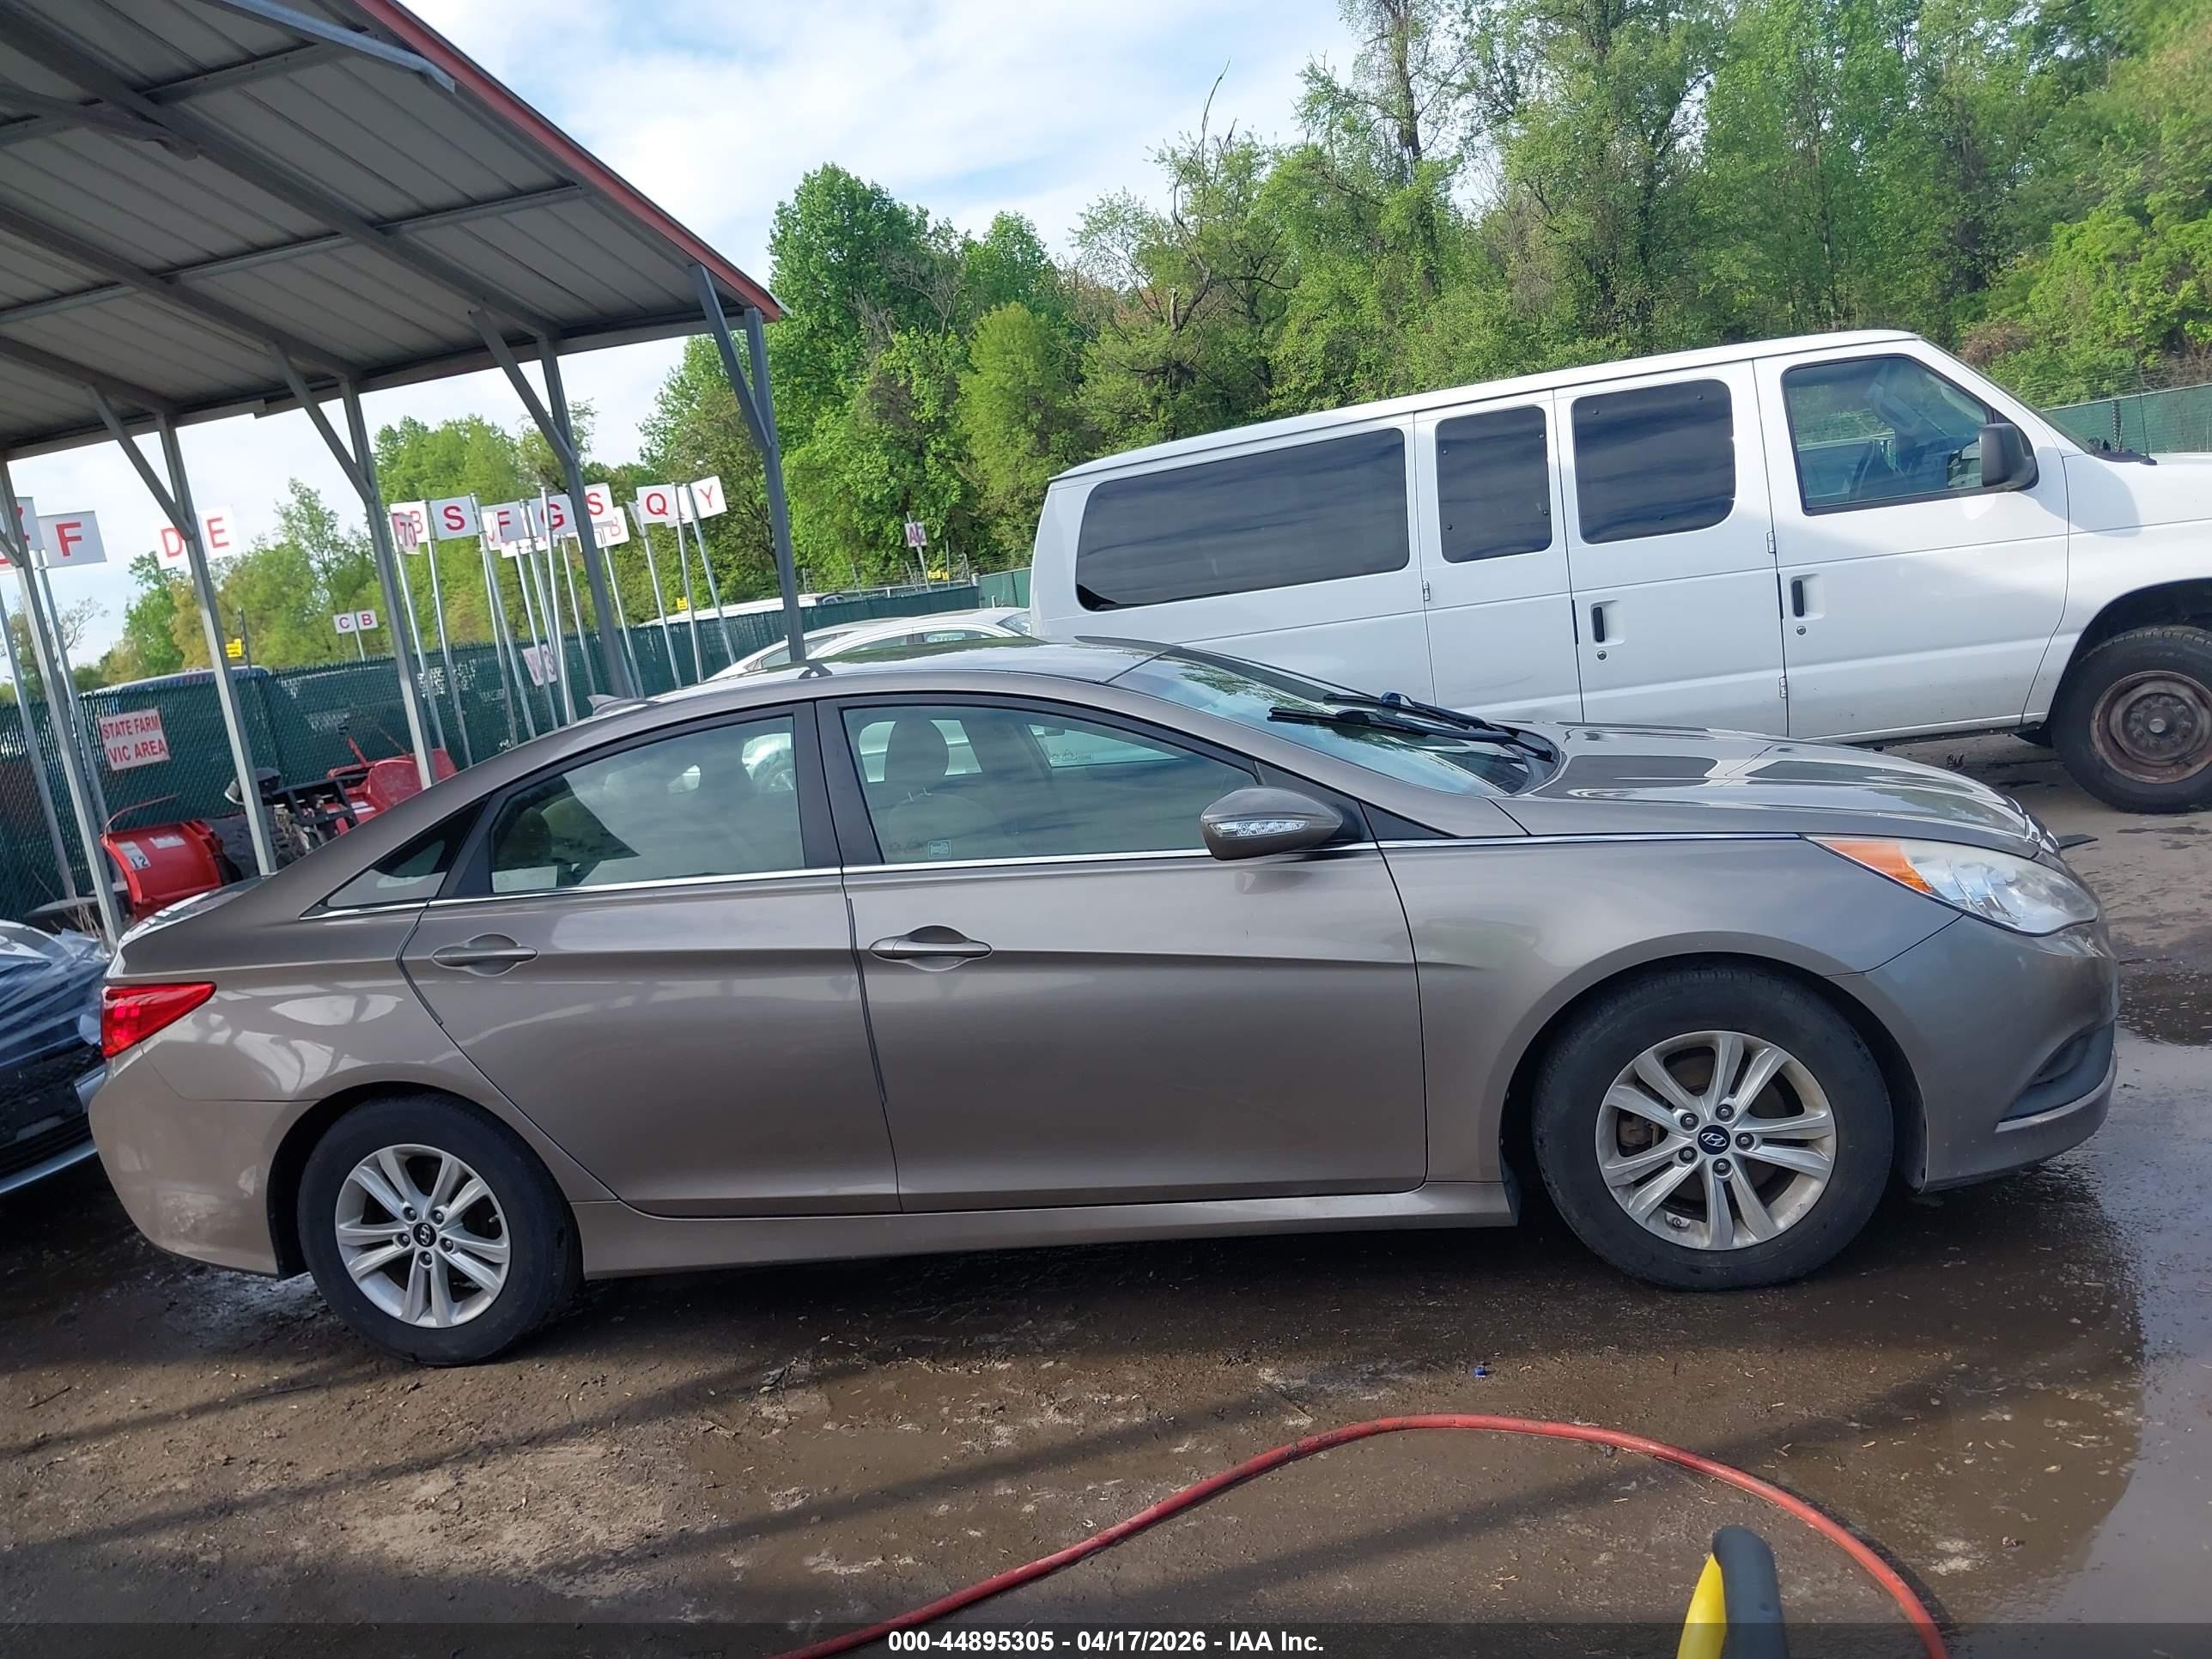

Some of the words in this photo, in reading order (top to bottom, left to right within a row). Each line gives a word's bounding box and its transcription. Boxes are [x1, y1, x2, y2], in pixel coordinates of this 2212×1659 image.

[586, 493, 604, 515] S
[646, 493, 669, 515] Q
[699, 485, 713, 508] Y
[443, 505, 466, 531] S
[497, 511, 511, 537] F
[540, 504, 564, 530] G
[56, 522, 82, 556] F
[161, 527, 183, 558] D
[206, 517, 230, 548] E
[339, 617, 350, 629] C
[362, 614, 373, 626] B
[102, 720, 133, 740] STATE
[134, 714, 160, 734] FARM
[108, 745, 131, 763] VIC
[134, 738, 167, 759] AREA
